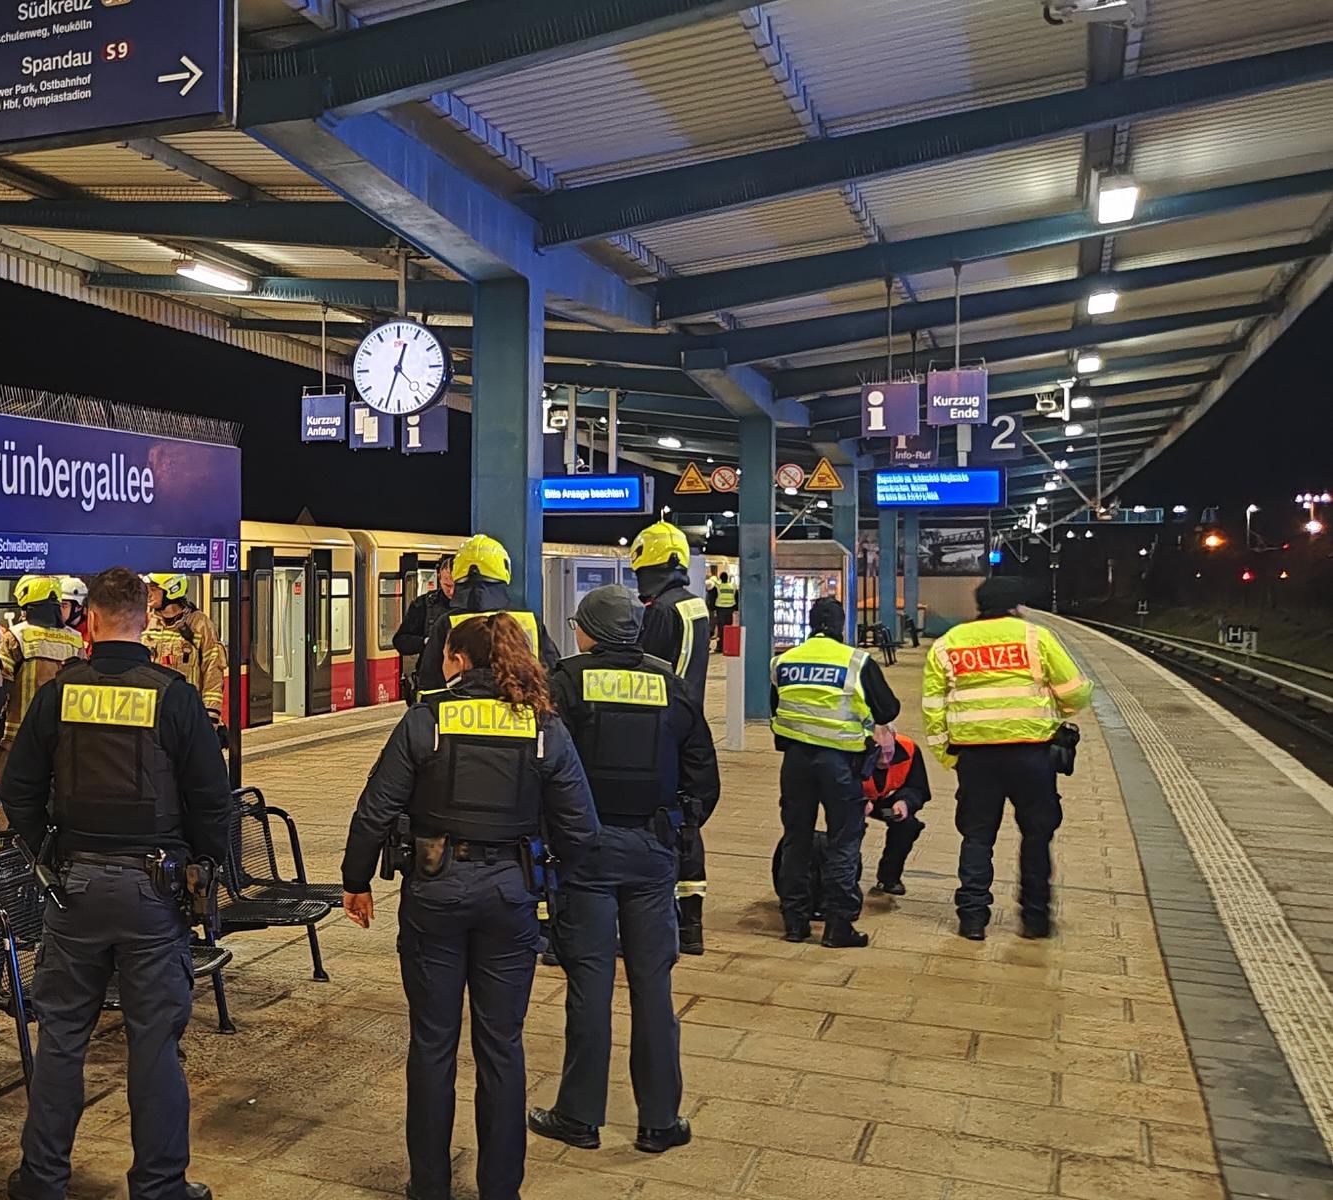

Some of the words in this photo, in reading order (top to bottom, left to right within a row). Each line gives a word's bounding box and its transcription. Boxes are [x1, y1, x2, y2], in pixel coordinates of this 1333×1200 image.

[53, 20, 92, 35] Neukölln
[21, 50, 92, 76] Spandau
[106, 42, 128, 60] S9
[15, 83, 37, 95] Park,
[40, 74, 92, 92] Ostbahnhof
[3, 99, 21, 111] Hbf,
[23, 89, 92, 108] Olympiastadion
[933, 395, 980, 408] Kurzzug
[306, 416, 341, 427] Kurzzug
[950, 408, 979, 419] Ende
[307, 426, 337, 439] Anfang
[991, 415, 1016, 450] 2
[895, 450, 931, 460] Info-Ruf
[1138, 600, 1148, 611] H
[1228, 627, 1242, 641] H
[950, 645, 1028, 673] POLIZEI
[780, 667, 840, 684] POLIZEI
[586, 672, 665, 701] POLIZEI
[65, 687, 153, 723] POLIZEI
